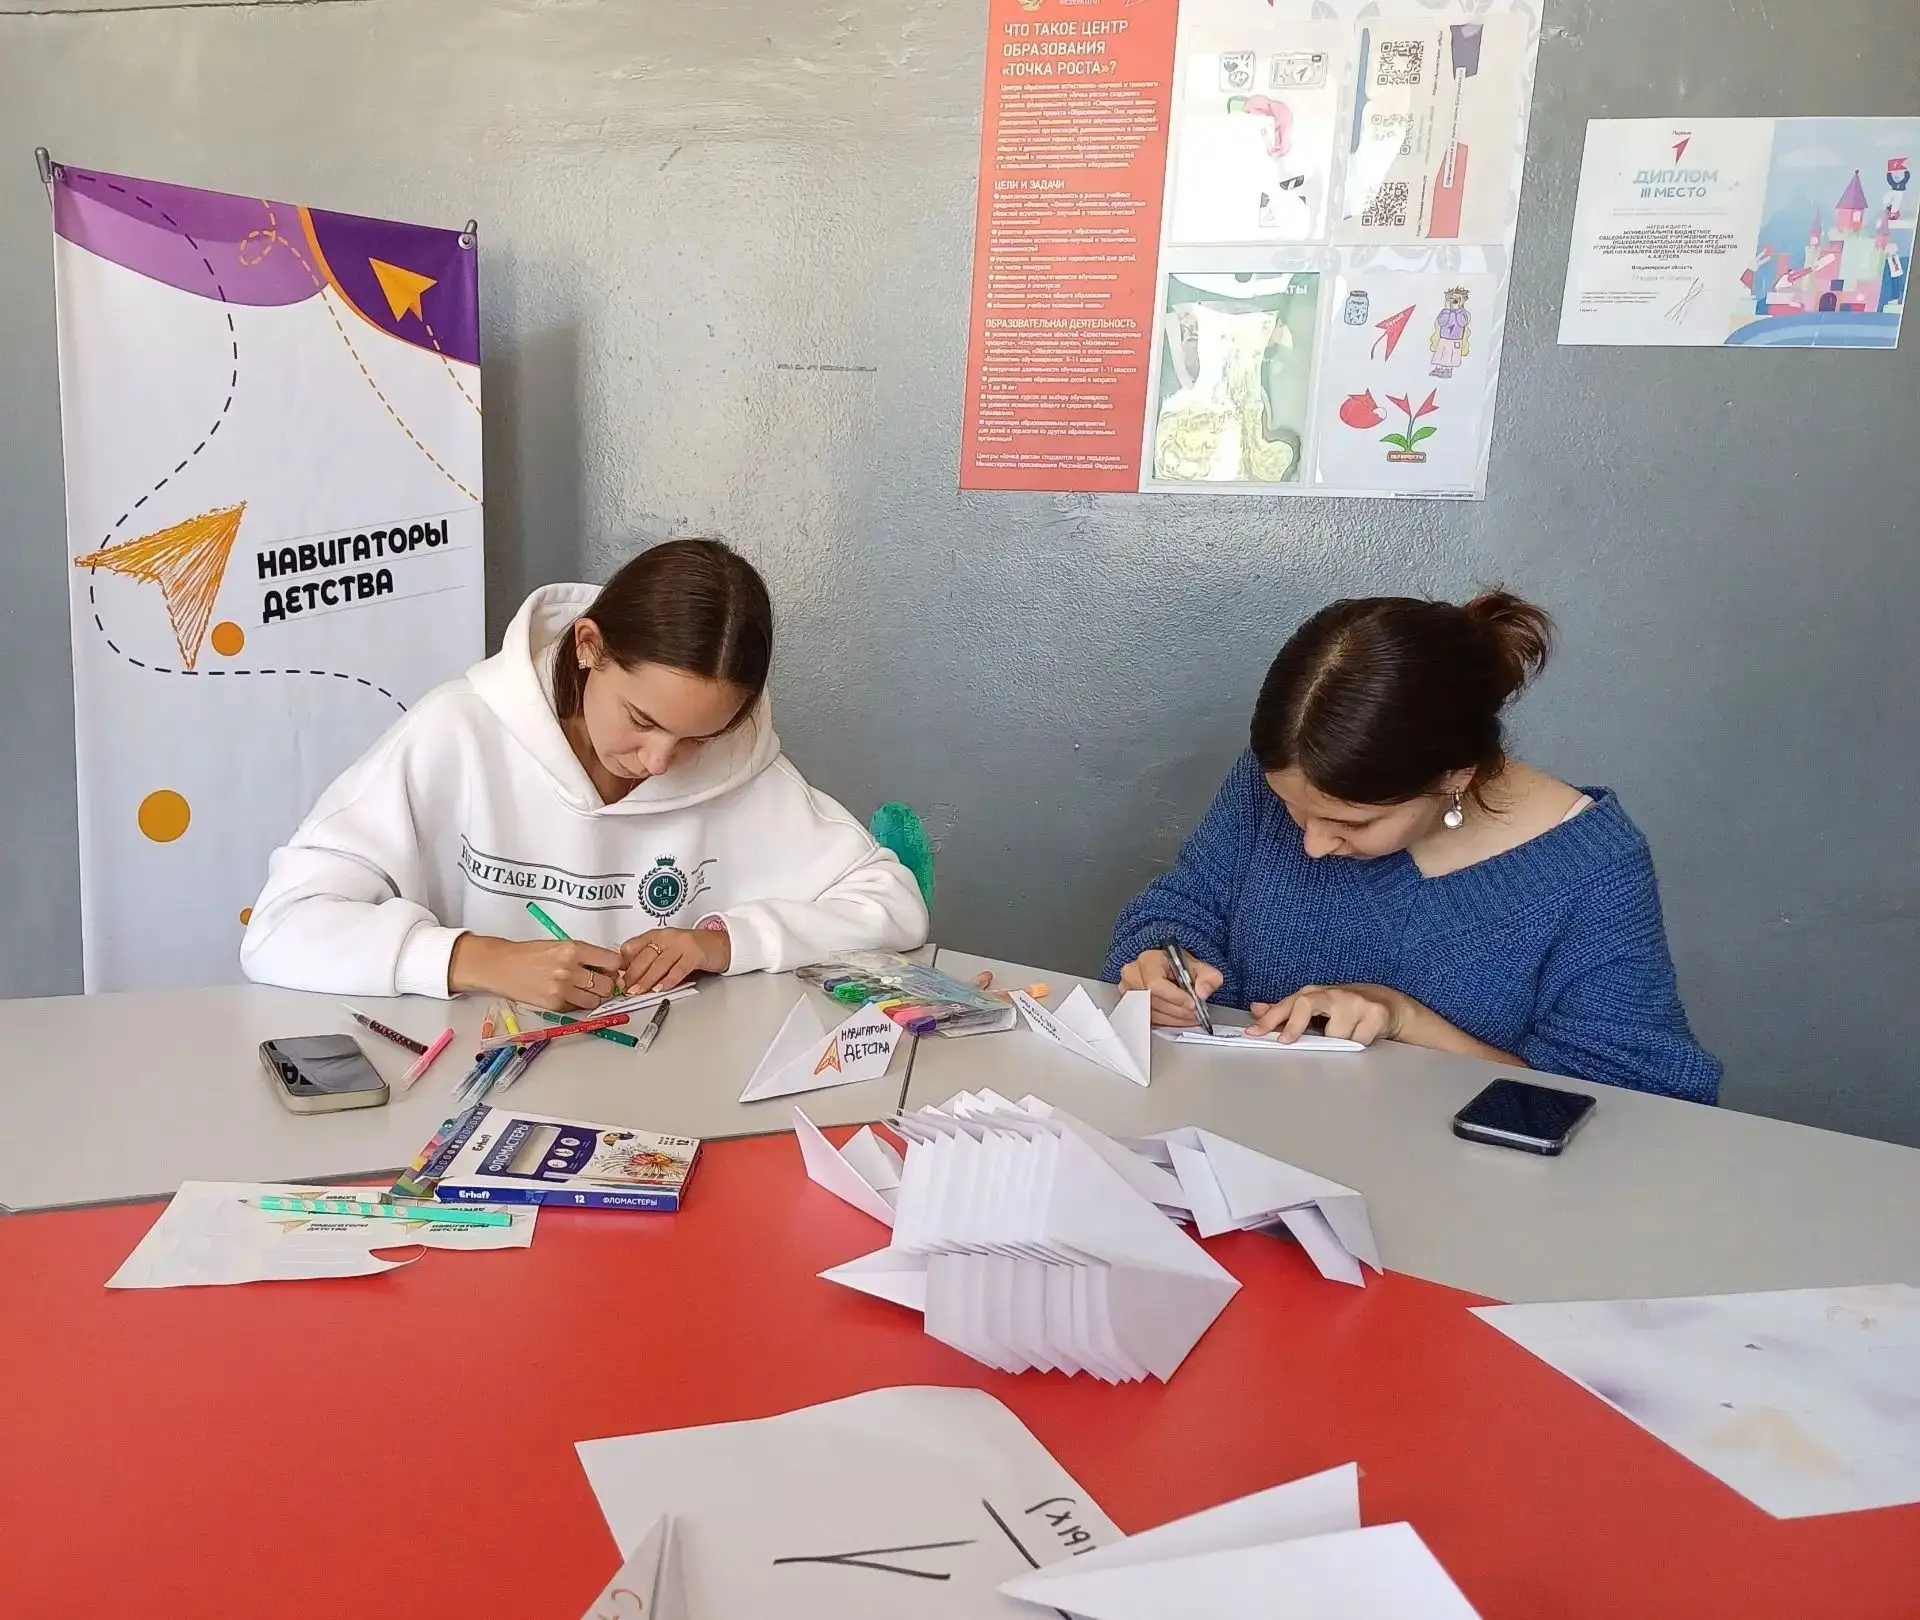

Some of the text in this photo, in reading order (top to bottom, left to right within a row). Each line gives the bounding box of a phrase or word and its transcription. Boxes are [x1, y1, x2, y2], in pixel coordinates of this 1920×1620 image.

[1004, 20, 1128, 37] ЧТО ТАКОЕ ЦЕНТР
[1003, 41, 1106, 57] ОБРАЗОВАНИЯ
[1002, 60, 1117, 76] «ТОЧКА РОСТА»?
[1633, 169, 1718, 185] ДИПЛОМ
[994, 180, 1065, 191] ЦЕЛИ И ЗАДАЧИ
[1640, 187, 1706, 198] III МЕСТО
[985, 319, 1137, 330] ОБРАЗОВАТЕЛЬНАЯ ДЕЯТЕЛЬНОСТЬ
[257, 519, 448, 579] НАВИГАТОРЫ
[263, 568, 393, 623] ДЕТСТВА
[460, 845, 626, 901] HERITAGE DIVISION
[653, 885, 676, 898] C&L
[841, 1023, 891, 1041] НАВИГАТОРЫ
[844, 1041, 890, 1063] ДЕТСТВА
[488, 1123, 530, 1172] ФЛОМАСТЕРЫ
[459, 1190, 490, 1200] Erhaft
[574, 1194, 585, 1204] 12
[602, 1194, 658, 1206] ФЛОМАСТЕРЫ
